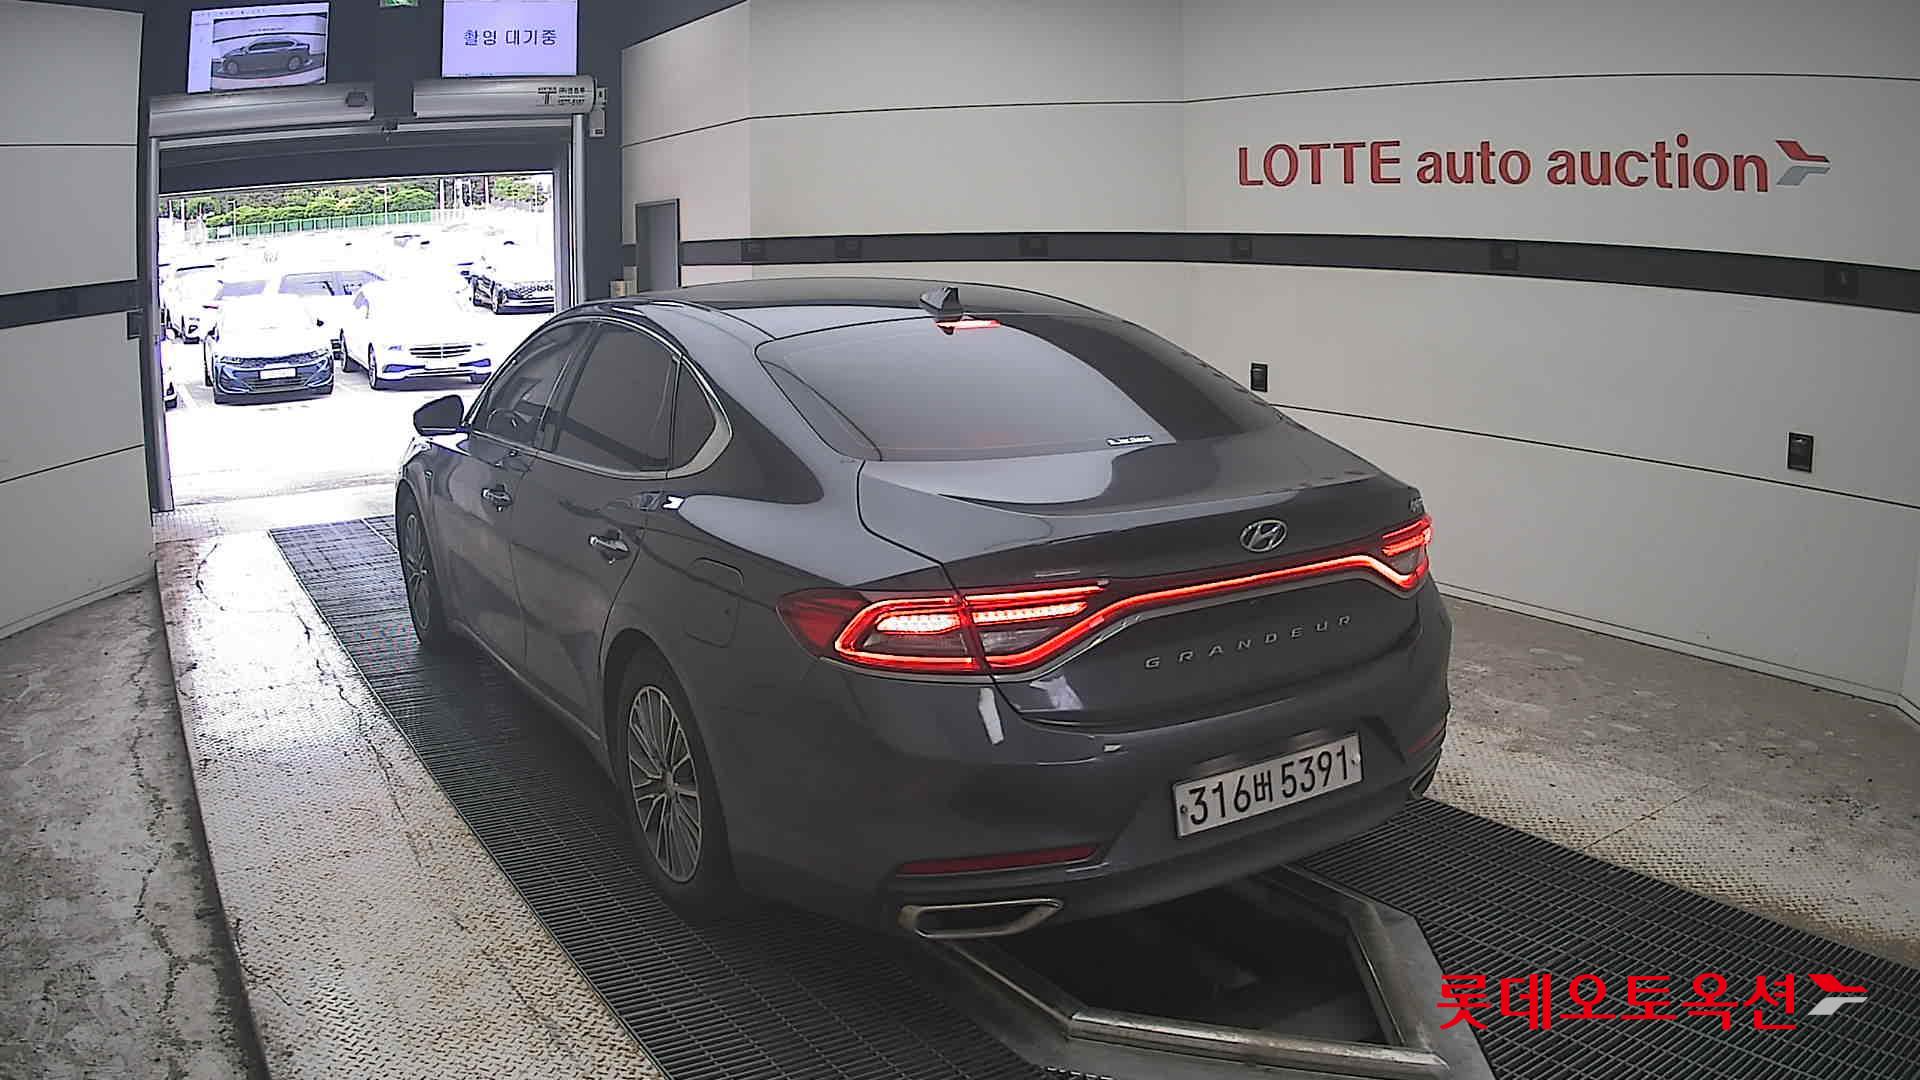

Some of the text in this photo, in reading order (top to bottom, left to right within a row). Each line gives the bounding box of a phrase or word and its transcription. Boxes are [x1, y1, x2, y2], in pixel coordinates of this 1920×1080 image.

[505, 29, 558, 46] 대기중
[1238, 133, 1769, 193] LOTTE auto auction
[1144, 615, 1351, 668] GRANDEUR
